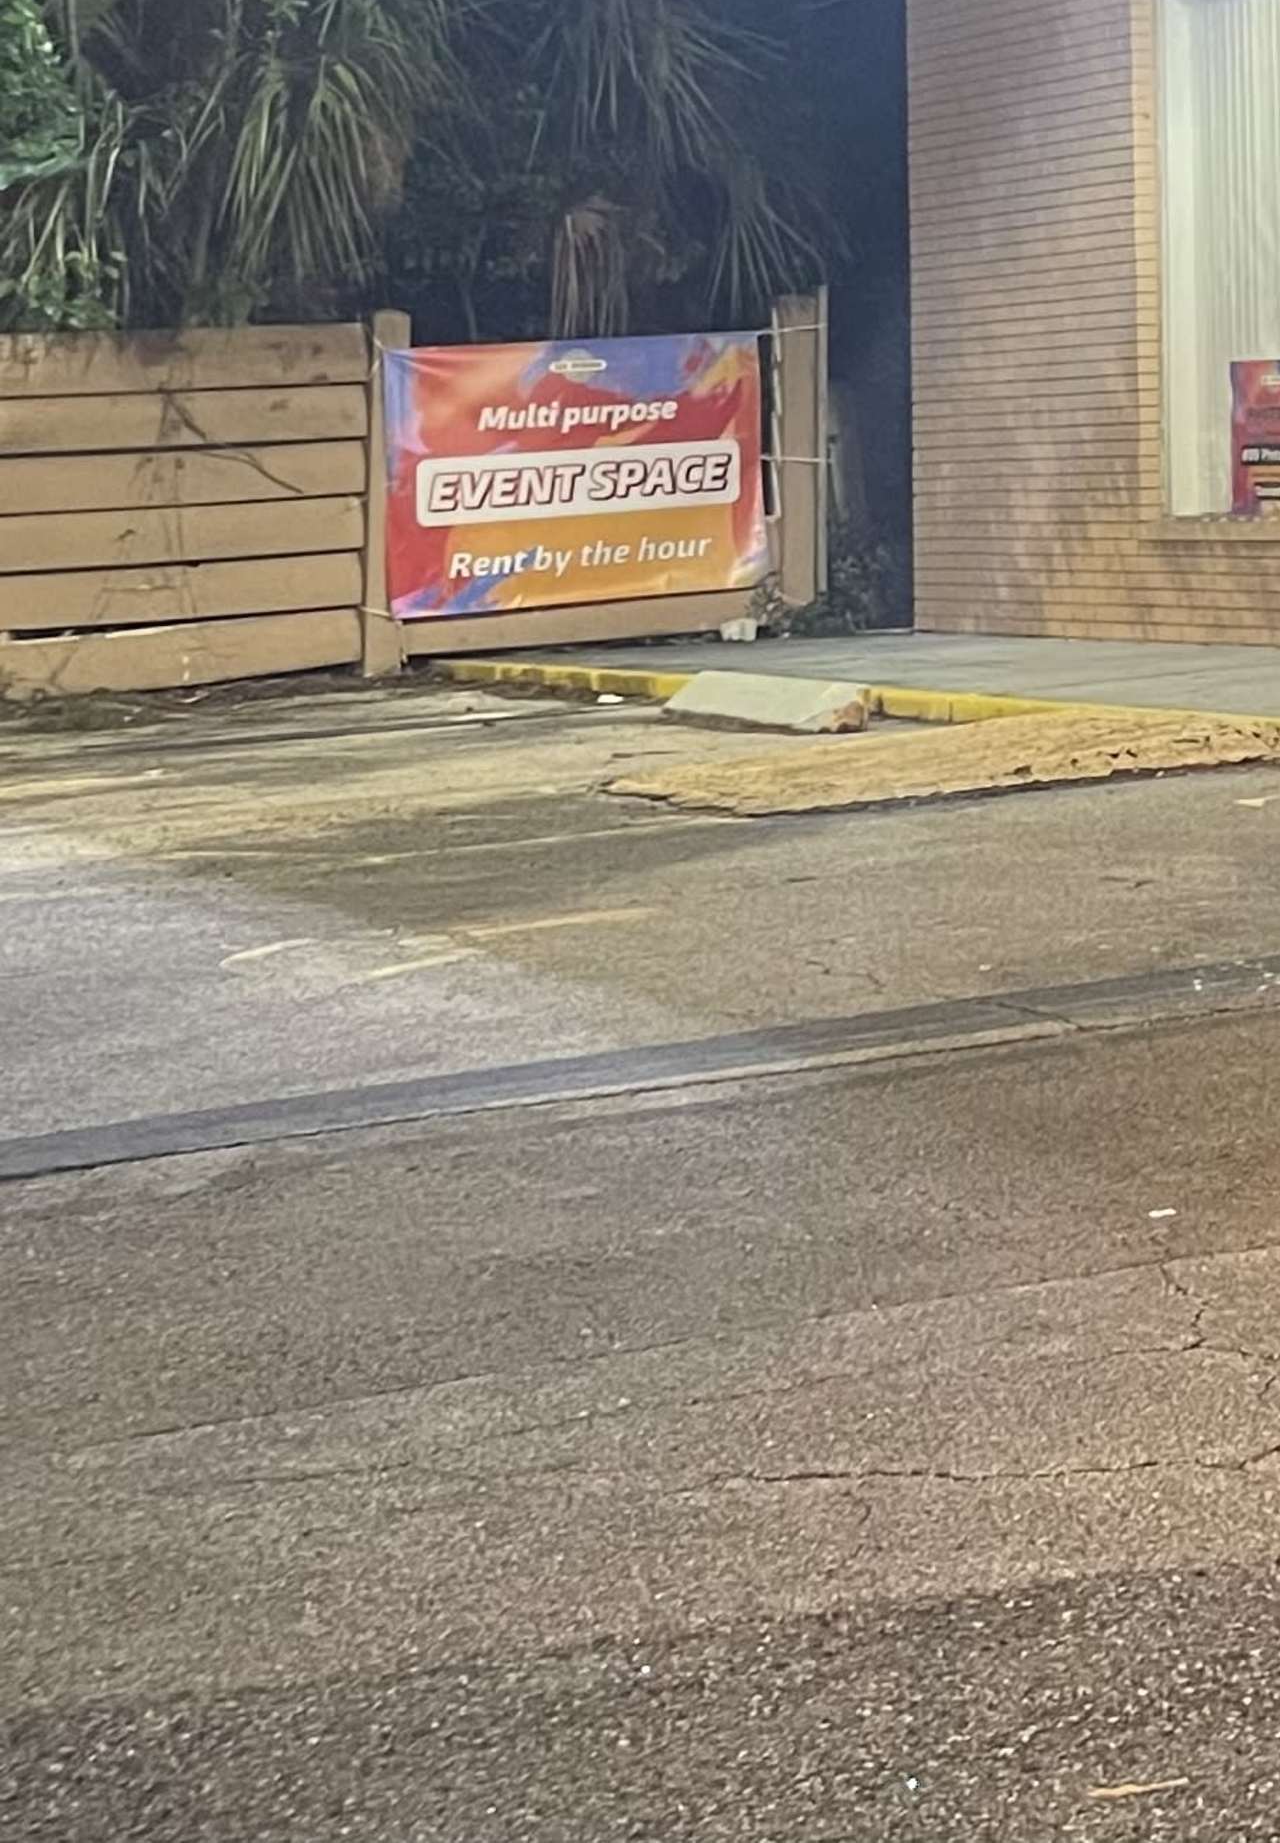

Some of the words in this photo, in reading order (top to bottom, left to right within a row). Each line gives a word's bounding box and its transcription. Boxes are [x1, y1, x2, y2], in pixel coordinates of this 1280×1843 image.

[478, 402, 559, 431] Multi
[561, 401, 677, 434] purpose
[428, 464, 585, 512] EVENT
[588, 454, 731, 500] SPACE
[450, 551, 531, 579] Rent
[533, 545, 572, 576] by
[580, 540, 630, 566] the
[637, 536, 712, 561] hour
